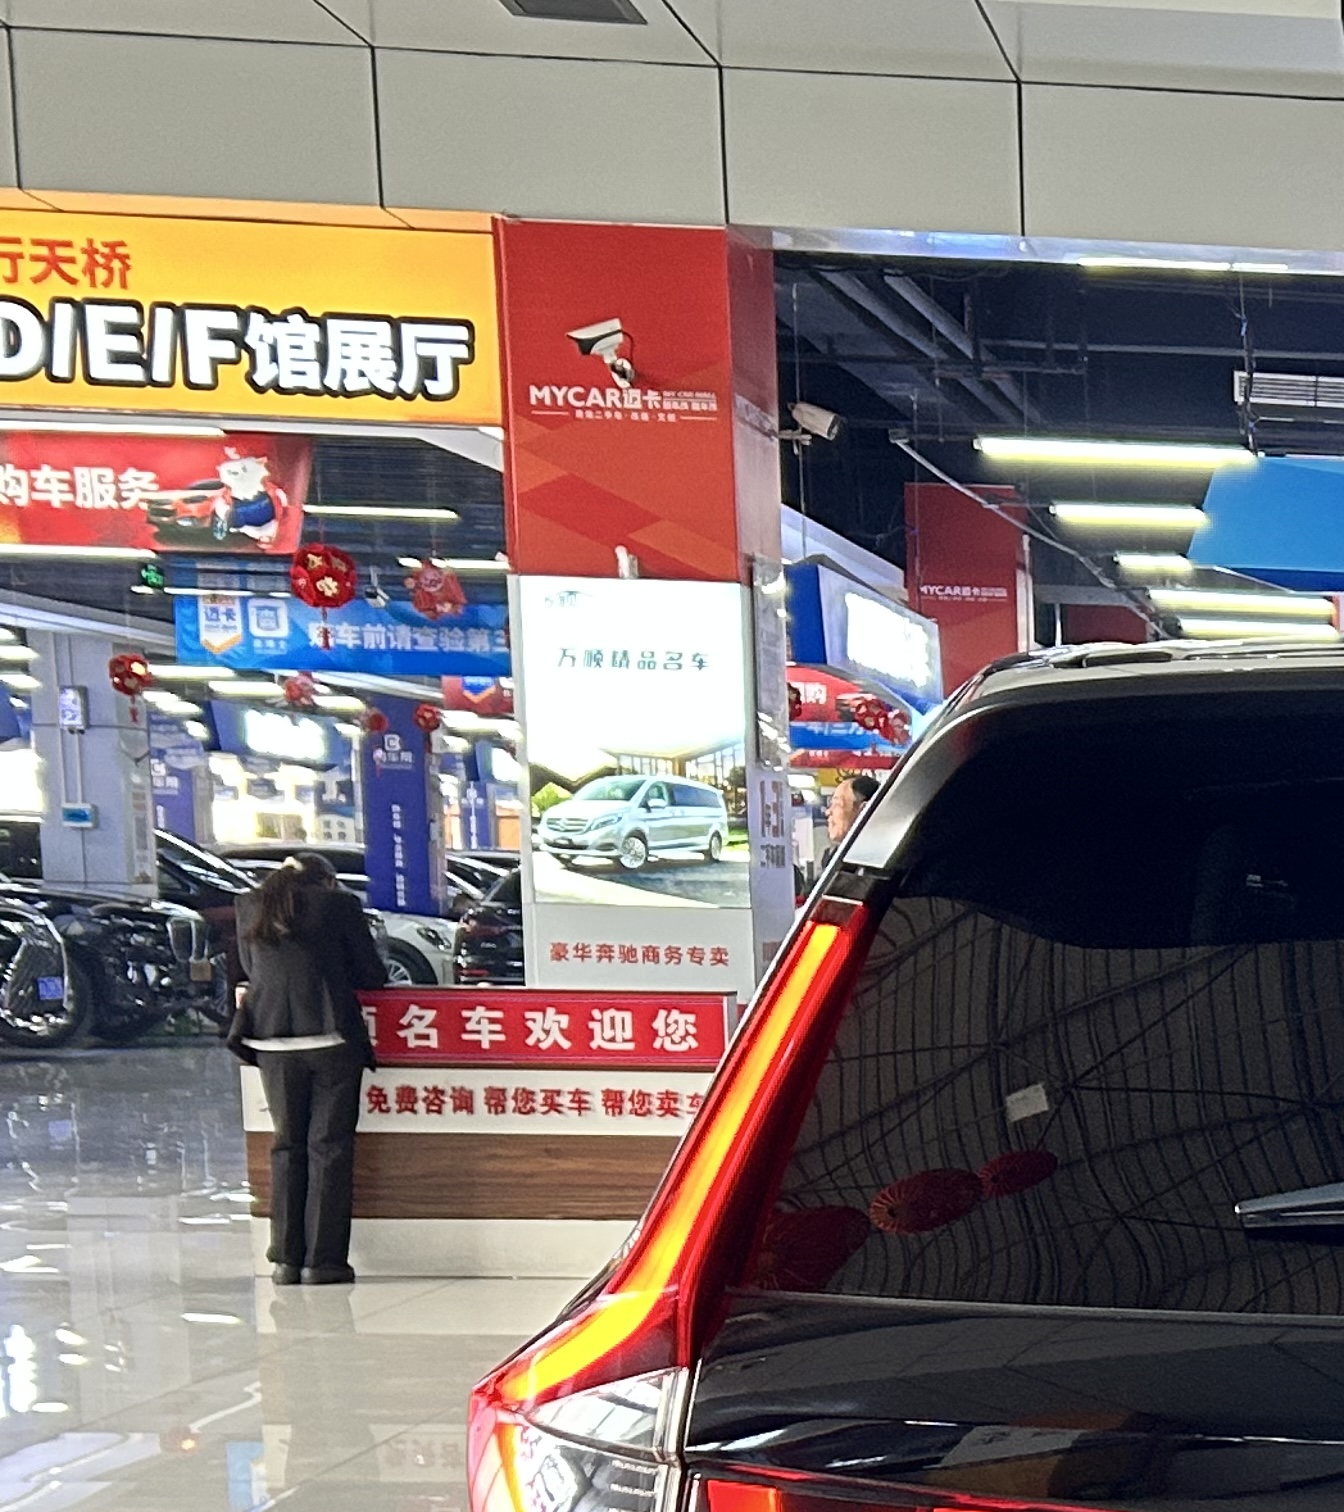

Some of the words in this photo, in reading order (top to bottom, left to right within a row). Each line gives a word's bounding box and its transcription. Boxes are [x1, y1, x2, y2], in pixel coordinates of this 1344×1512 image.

[0, 300, 471, 397] D/E/F馆展厅
[557, 647, 710, 671] 万顺精品名车
[550, 942, 730, 967] 豪华奔驰商务专卖
[366, 1084, 475, 1116] 免费咨询
[484, 1086, 593, 1117] 帮您买车
[601, 1087, 705, 1118] 帮您卖车
